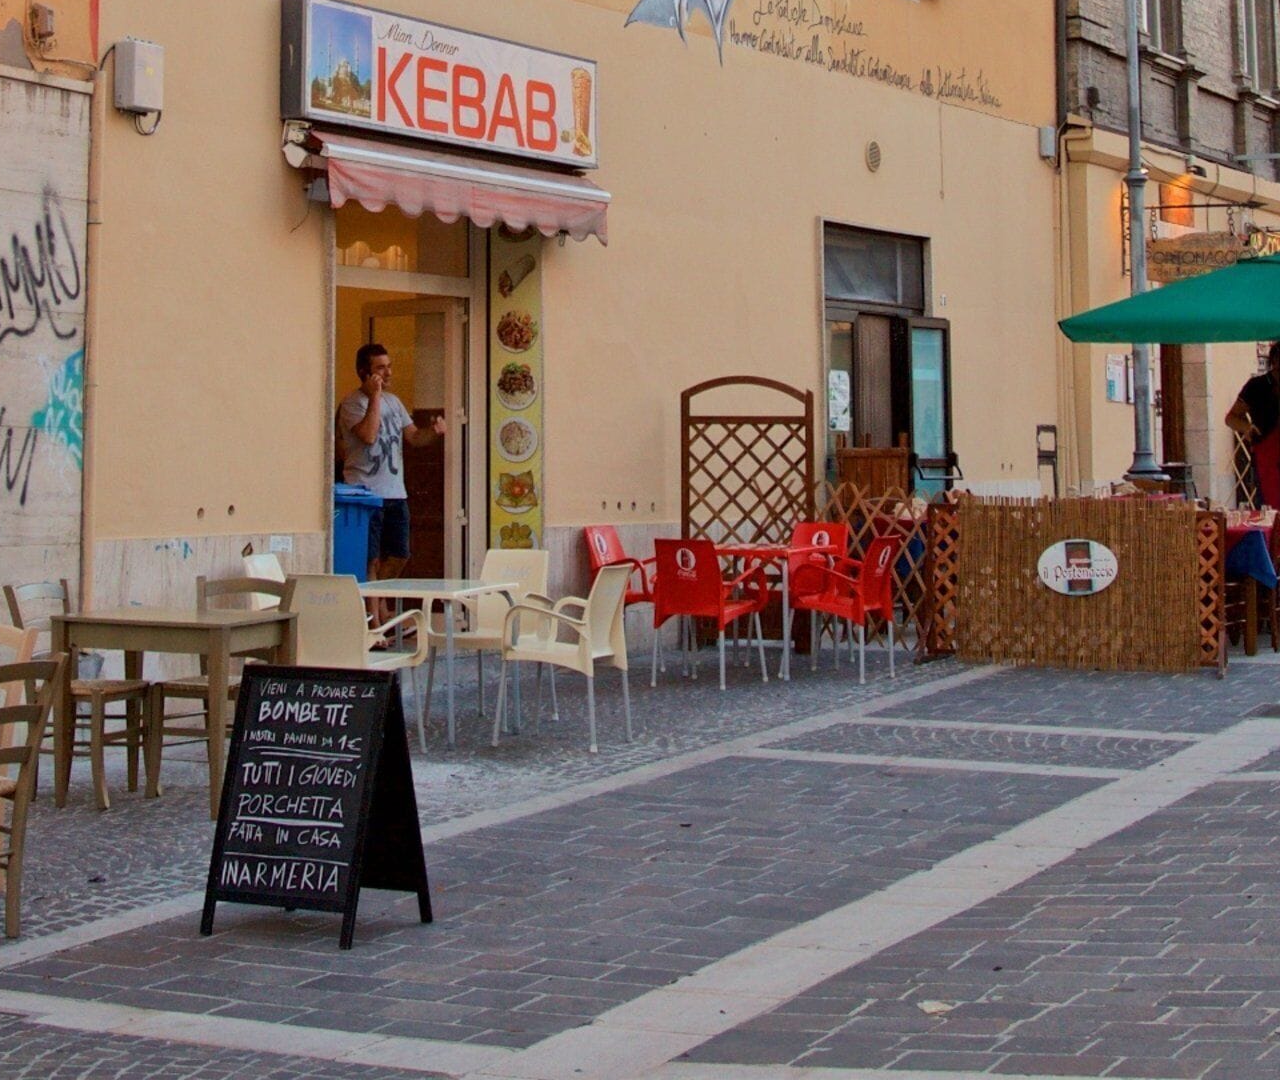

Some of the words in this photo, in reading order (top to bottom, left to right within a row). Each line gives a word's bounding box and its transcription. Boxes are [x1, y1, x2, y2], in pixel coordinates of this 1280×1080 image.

[376, 46, 558, 153] KEBAB
[260, 679, 288, 698] VIENI
[296, 682, 305, 698] A
[310, 684, 358, 700] PROVARE
[360, 686, 376, 699] LE
[258, 700, 354, 727] BOMBETTE
[283, 731, 318, 746] PANINI
[241, 761, 281, 787] TUTTI
[287, 768, 294, 787] I
[237, 792, 344, 820] PORCHETTA
[227, 821, 264, 844] FATTA
[275, 826, 290, 845] IN
[297, 827, 342, 850] CASA
[220, 859, 340, 894] INARMERIA
